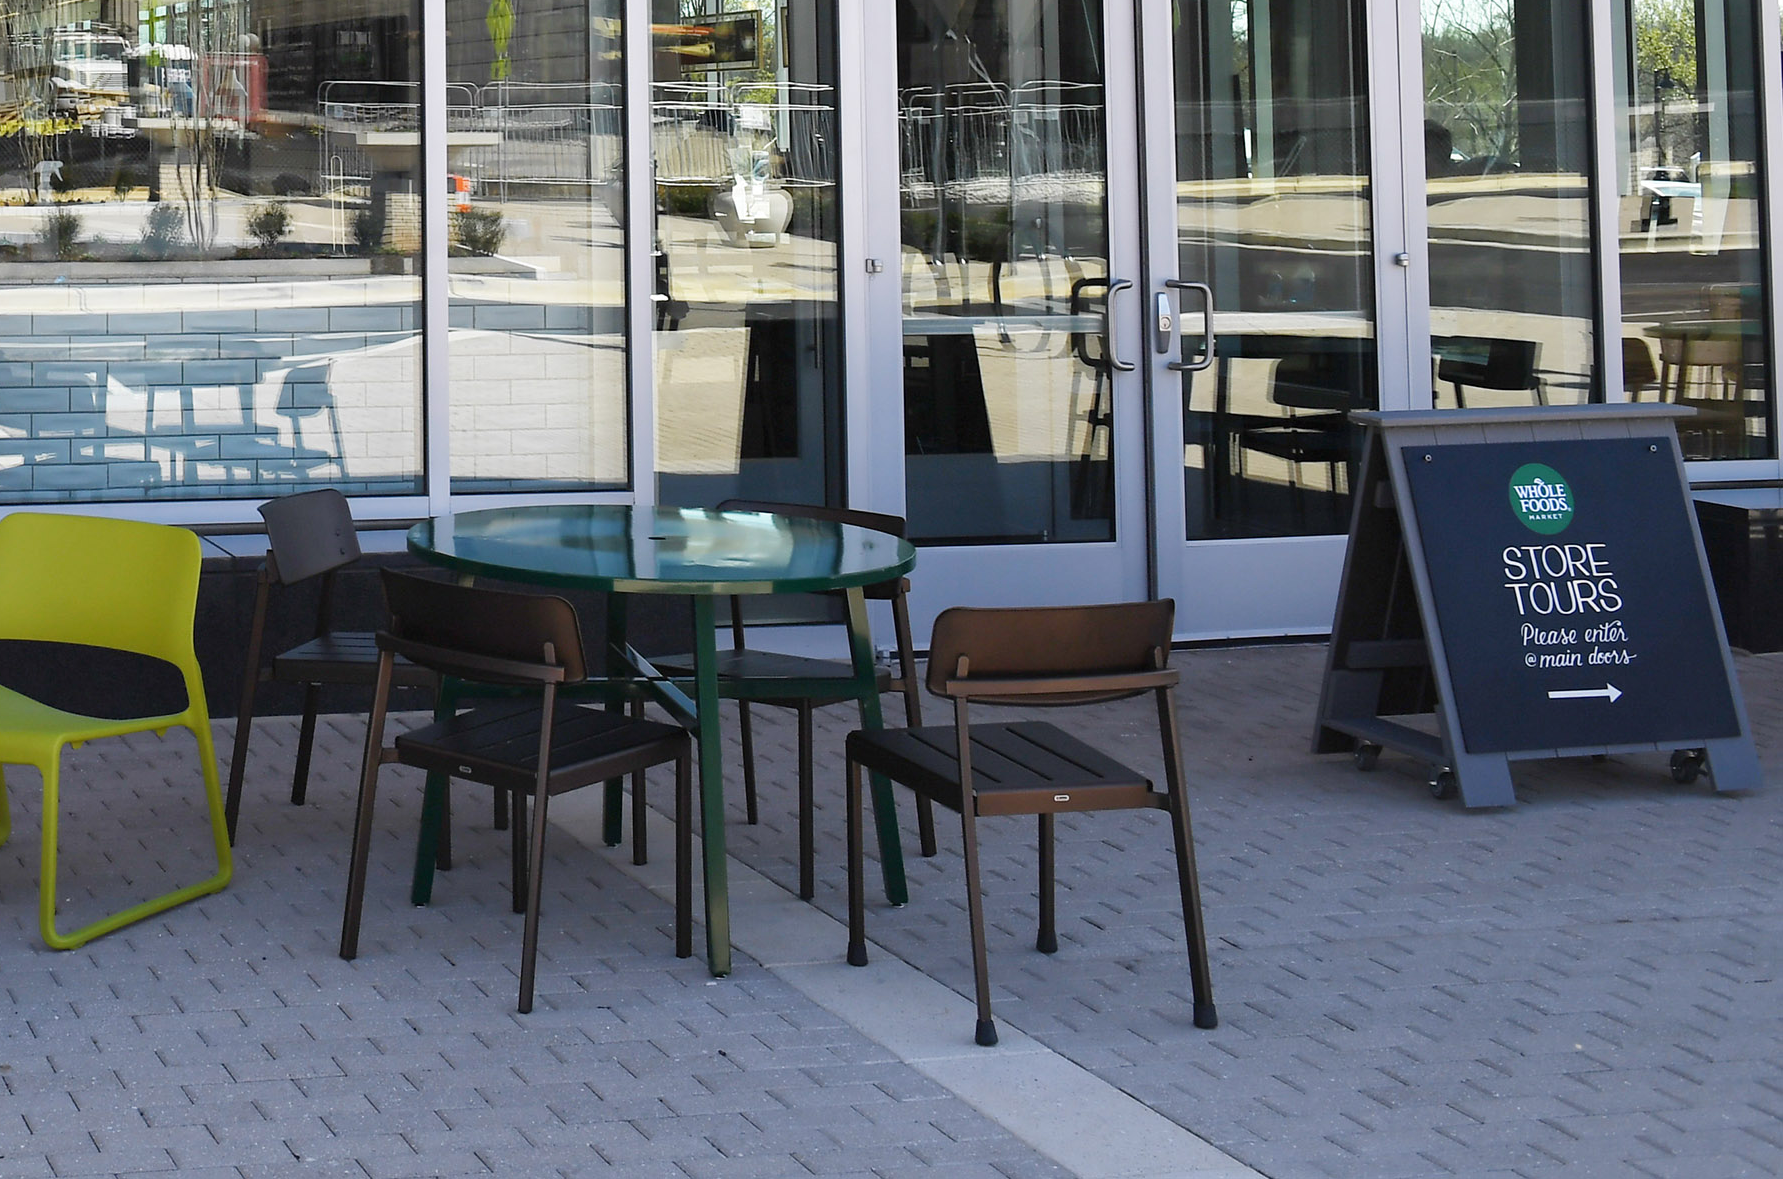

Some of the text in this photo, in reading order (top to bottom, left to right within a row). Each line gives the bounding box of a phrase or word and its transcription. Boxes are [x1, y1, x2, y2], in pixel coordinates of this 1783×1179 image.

[1513, 477, 1566, 499] WHOLE
[1519, 497, 1568, 513] FOODS
[1528, 513, 1563, 521] MARKET
[1502, 543, 1614, 580] STORE
[1504, 578, 1623, 615] TOURS
[1521, 620, 1628, 646] Please enter
[1588, 646, 1637, 666] doors
